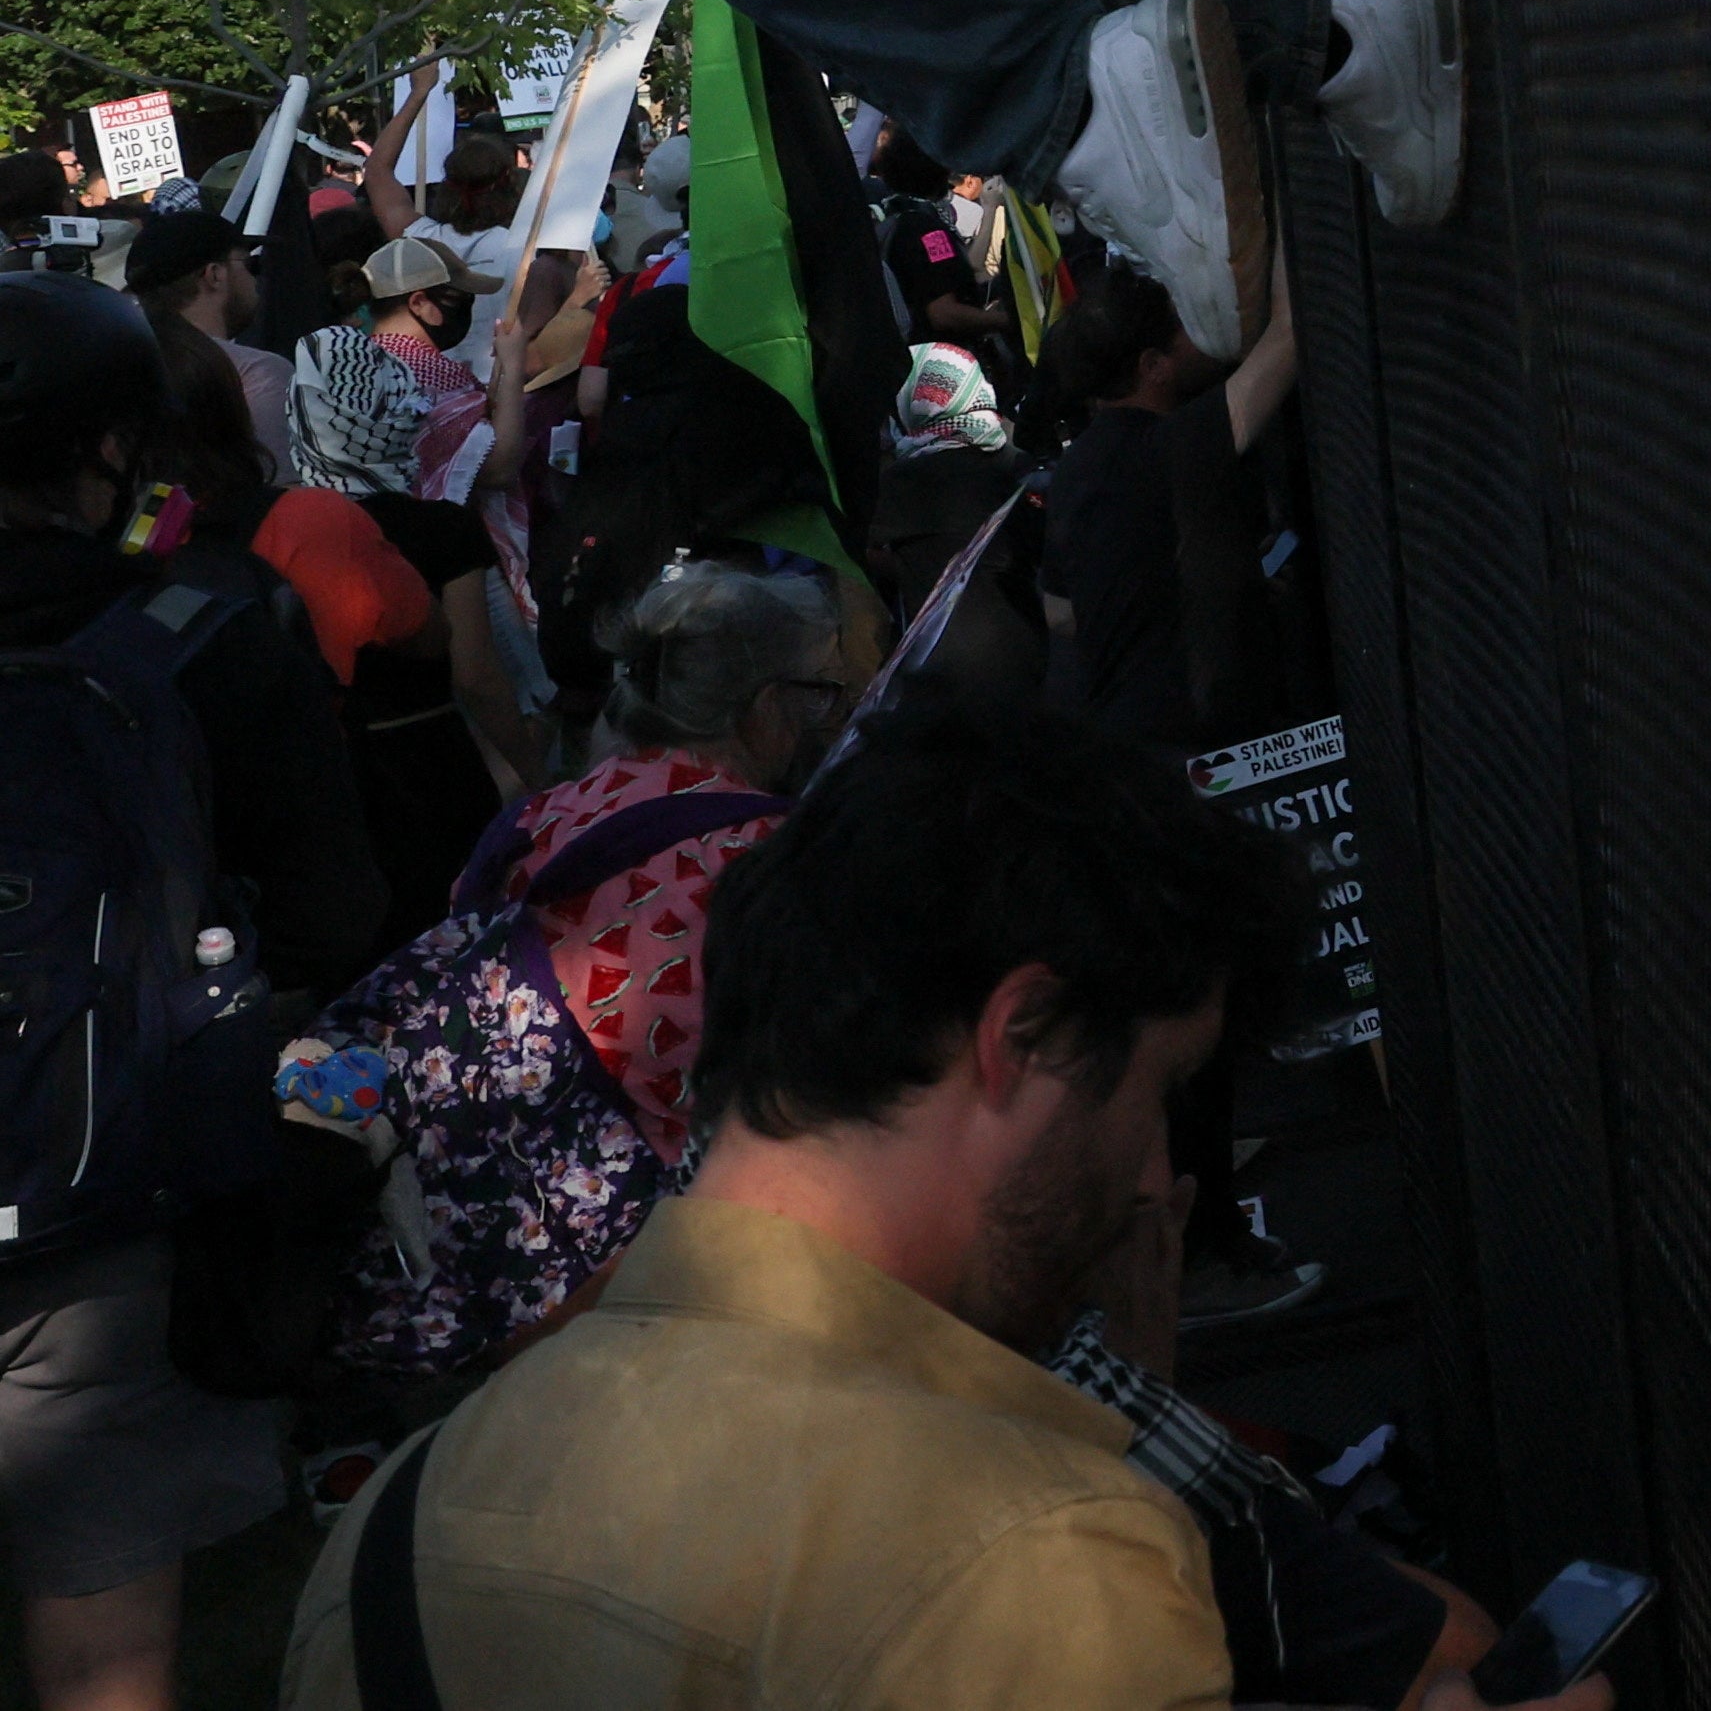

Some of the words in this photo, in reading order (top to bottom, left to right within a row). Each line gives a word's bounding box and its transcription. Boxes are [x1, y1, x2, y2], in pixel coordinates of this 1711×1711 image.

[536, 60, 571, 77] ALL
[100, 101, 138, 117] STAND
[140, 93, 168, 109] WITH
[101, 104, 170, 128] PALESTINE!
[108, 128, 140, 145] END
[146, 121, 170, 137] U.S
[113, 143, 143, 162] AID
[150, 136, 173, 152] TO
[115, 151, 176, 176] ISRAEL!
[1240, 733, 1295, 761] STAND
[1299, 718, 1343, 743] WITH
[1250, 738, 1343, 777] PALESTINE!
[1353, 1016, 1380, 1037] AID
